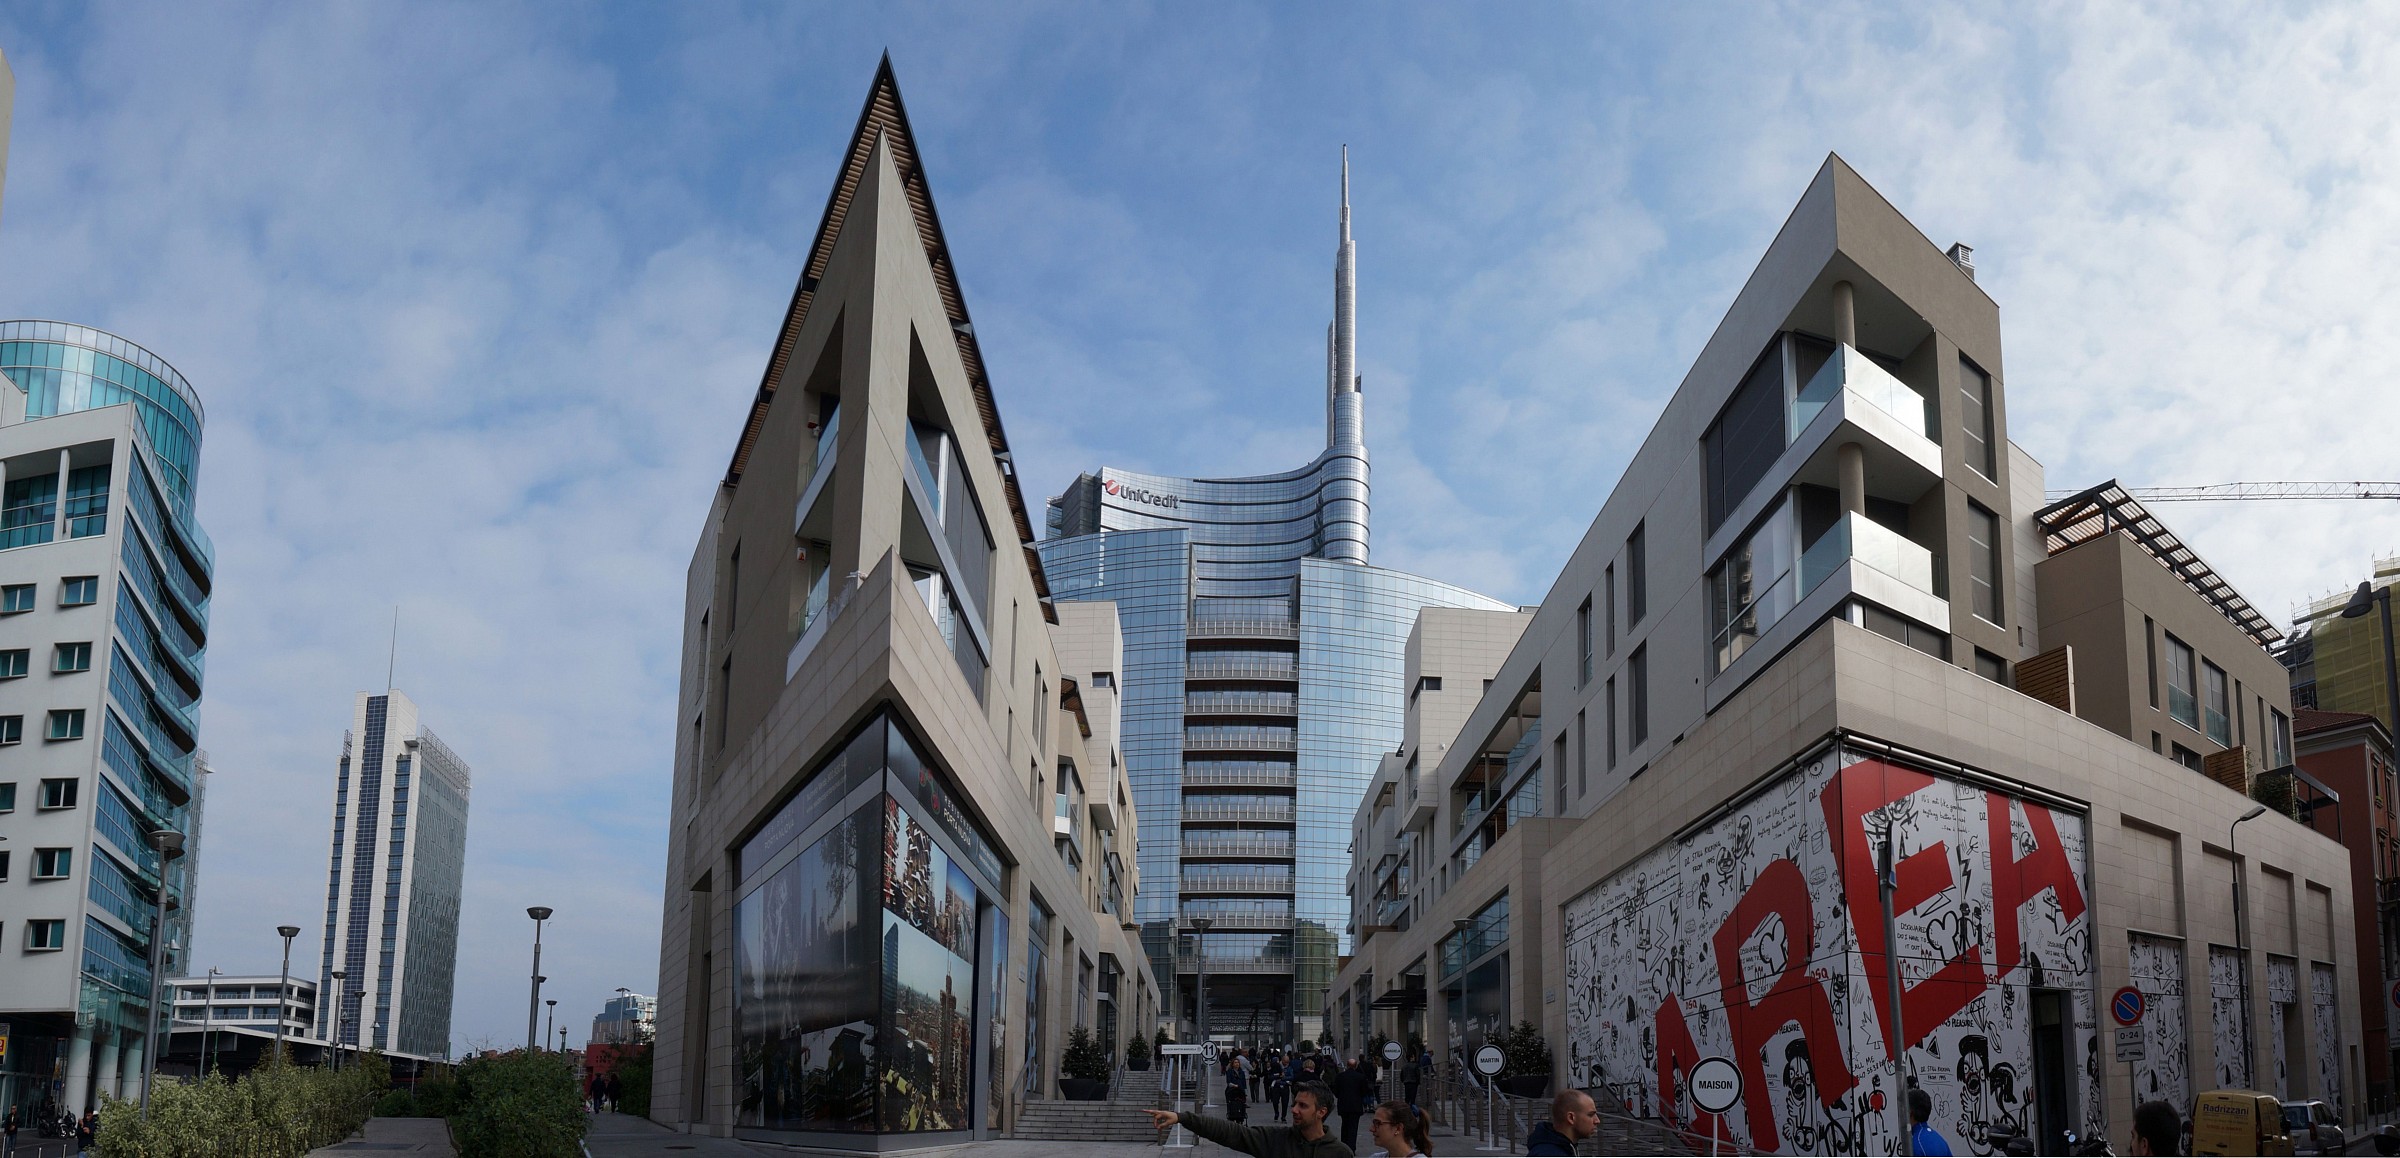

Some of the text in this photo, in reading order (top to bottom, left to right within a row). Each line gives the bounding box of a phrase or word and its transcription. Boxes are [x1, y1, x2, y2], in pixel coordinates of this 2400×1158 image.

[1120, 484, 1179, 509] UniCredit
[943, 807, 958, 831] PORTA
[1655, 757, 2087, 1156] AREA
[1685, 999, 1698, 1010] DSQ
[2120, 1031, 2139, 1040] 0-24
[1203, 1044, 1214, 1056] 11
[1323, 1047, 1331, 1055] 11
[1698, 1081, 1733, 1090] MAISON
[2203, 1103, 2249, 1116] Radrizzani
